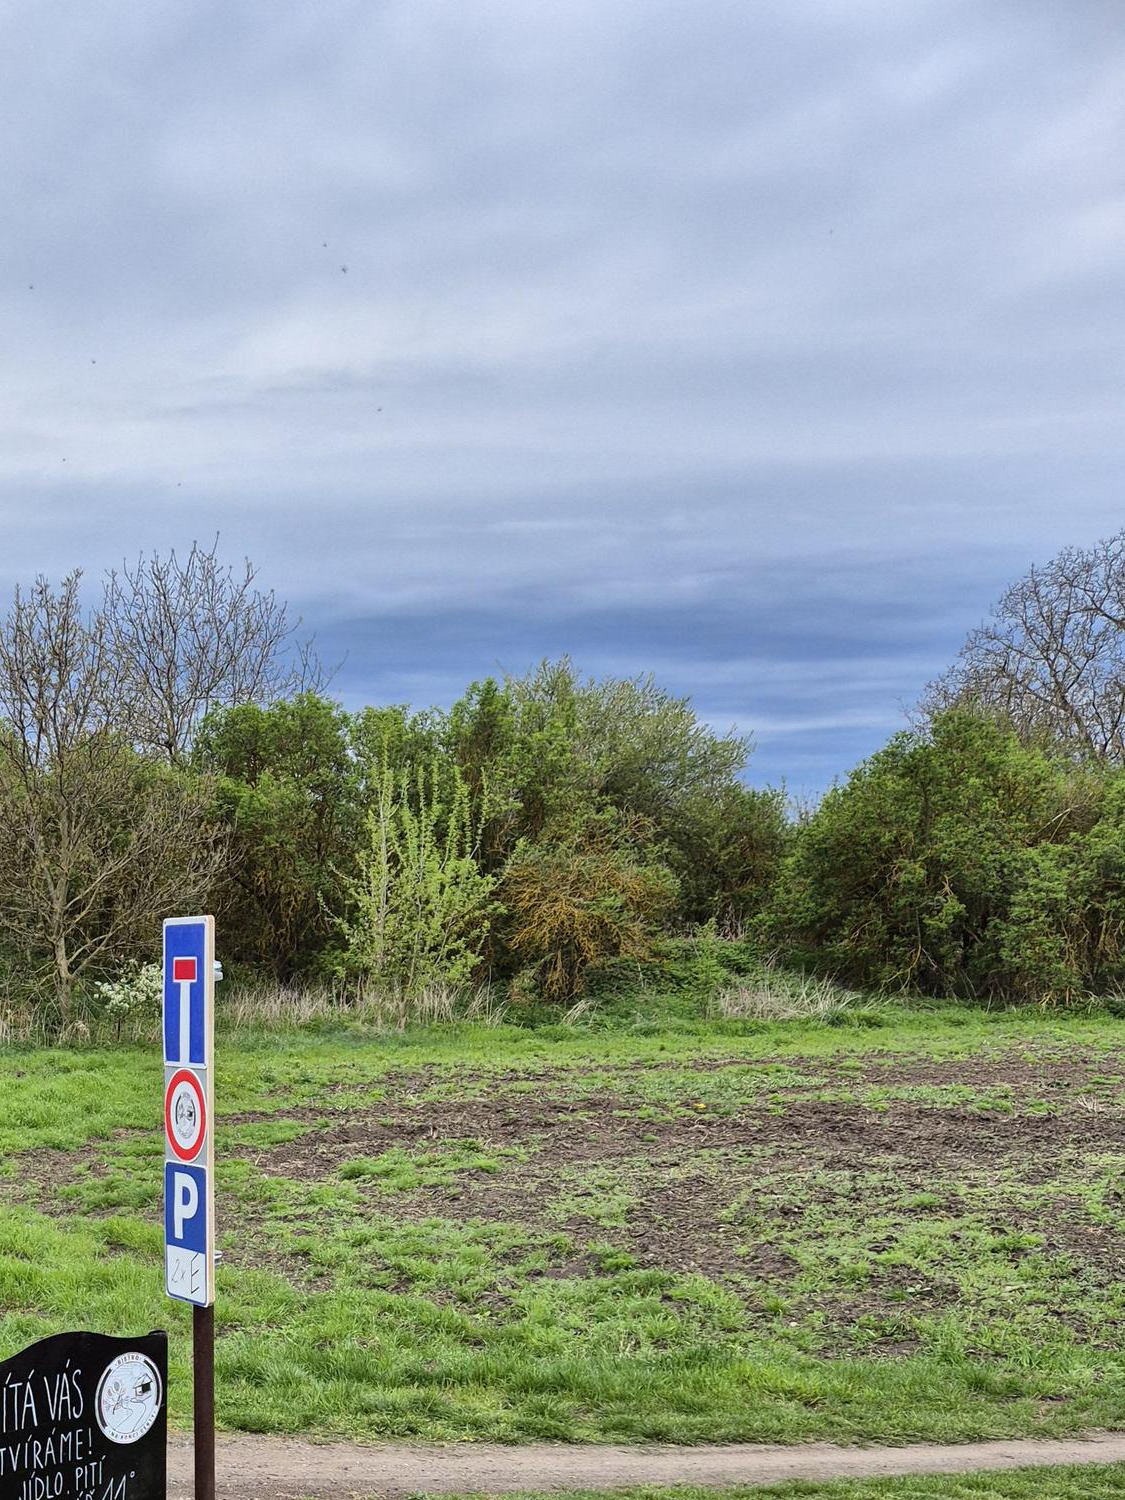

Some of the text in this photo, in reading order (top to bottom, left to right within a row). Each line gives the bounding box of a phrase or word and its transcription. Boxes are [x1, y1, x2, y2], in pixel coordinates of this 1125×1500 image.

[173, 1171, 199, 1240] P
[43, 1358, 84, 1421] VÁS
[75, 1455, 106, 1491] PITÍ
